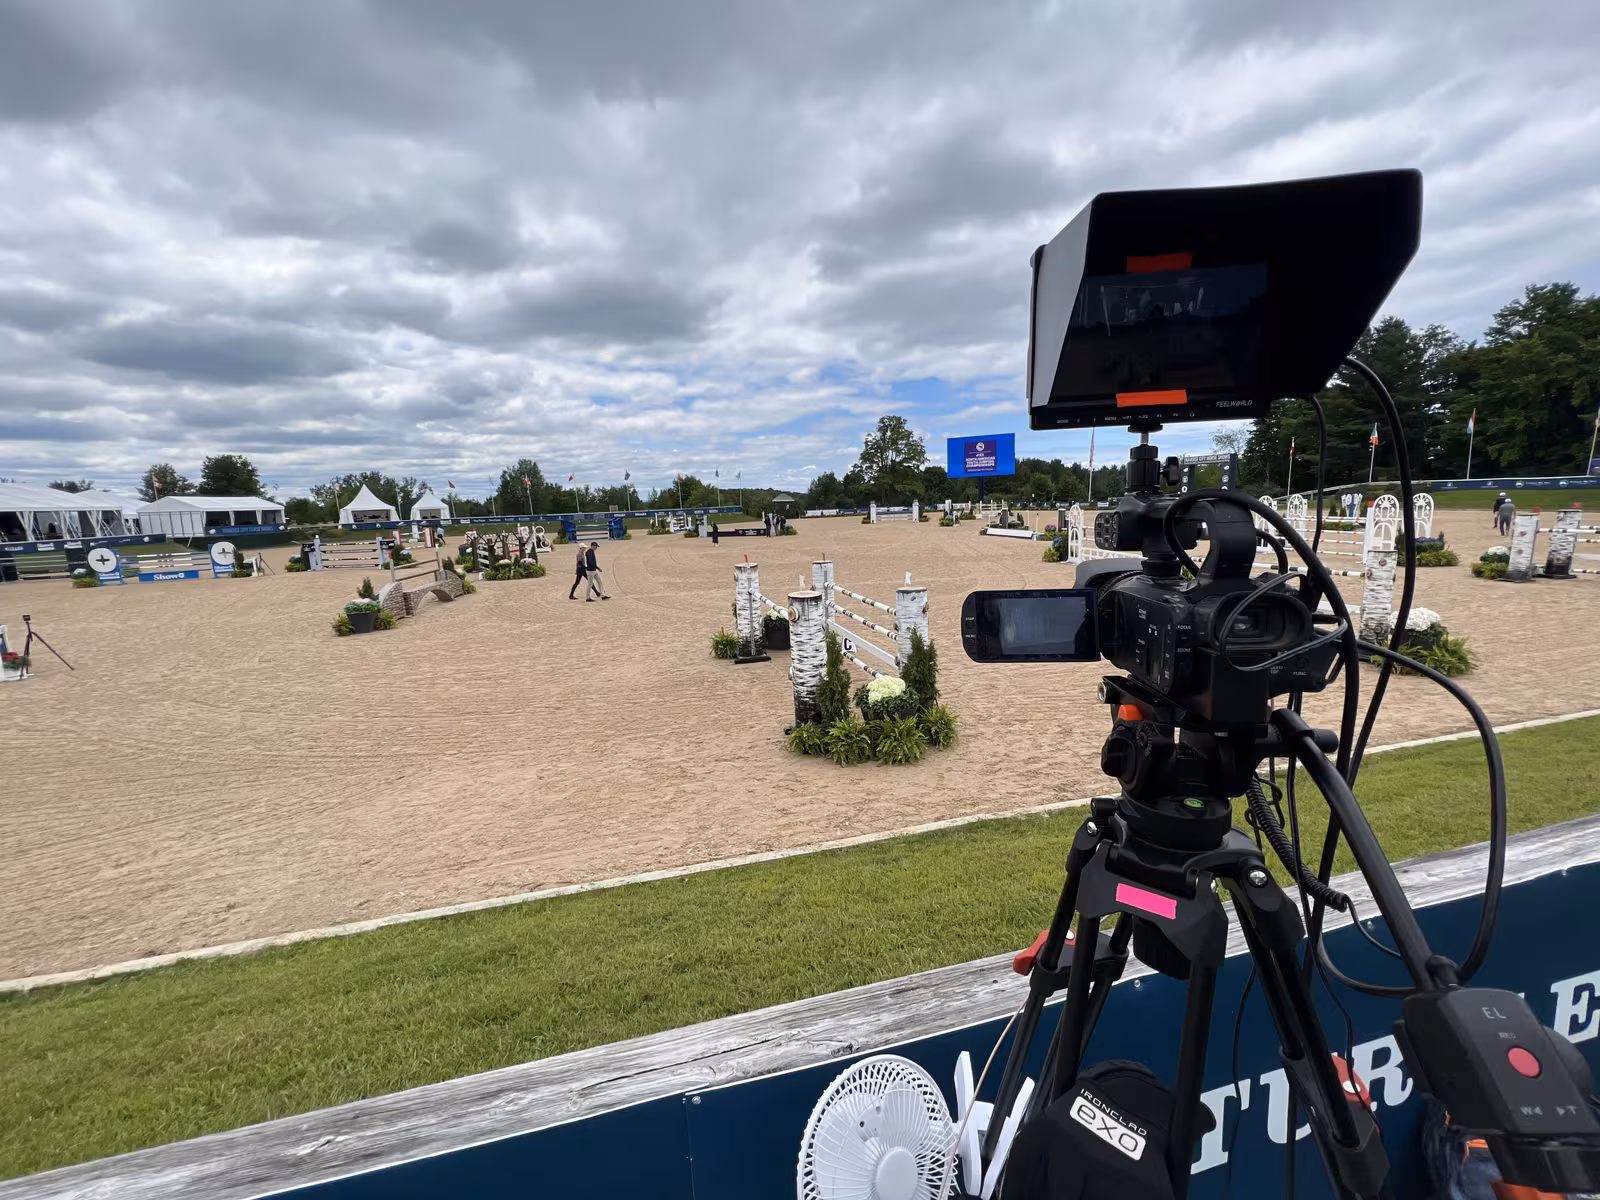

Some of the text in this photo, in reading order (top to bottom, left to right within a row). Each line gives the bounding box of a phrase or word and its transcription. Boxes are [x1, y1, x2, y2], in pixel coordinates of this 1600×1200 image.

[1215, 400, 1253, 408] FEELWORLD
[844, 638, 852, 651] C
[1080, 1088, 1148, 1136] IRONCLAD
